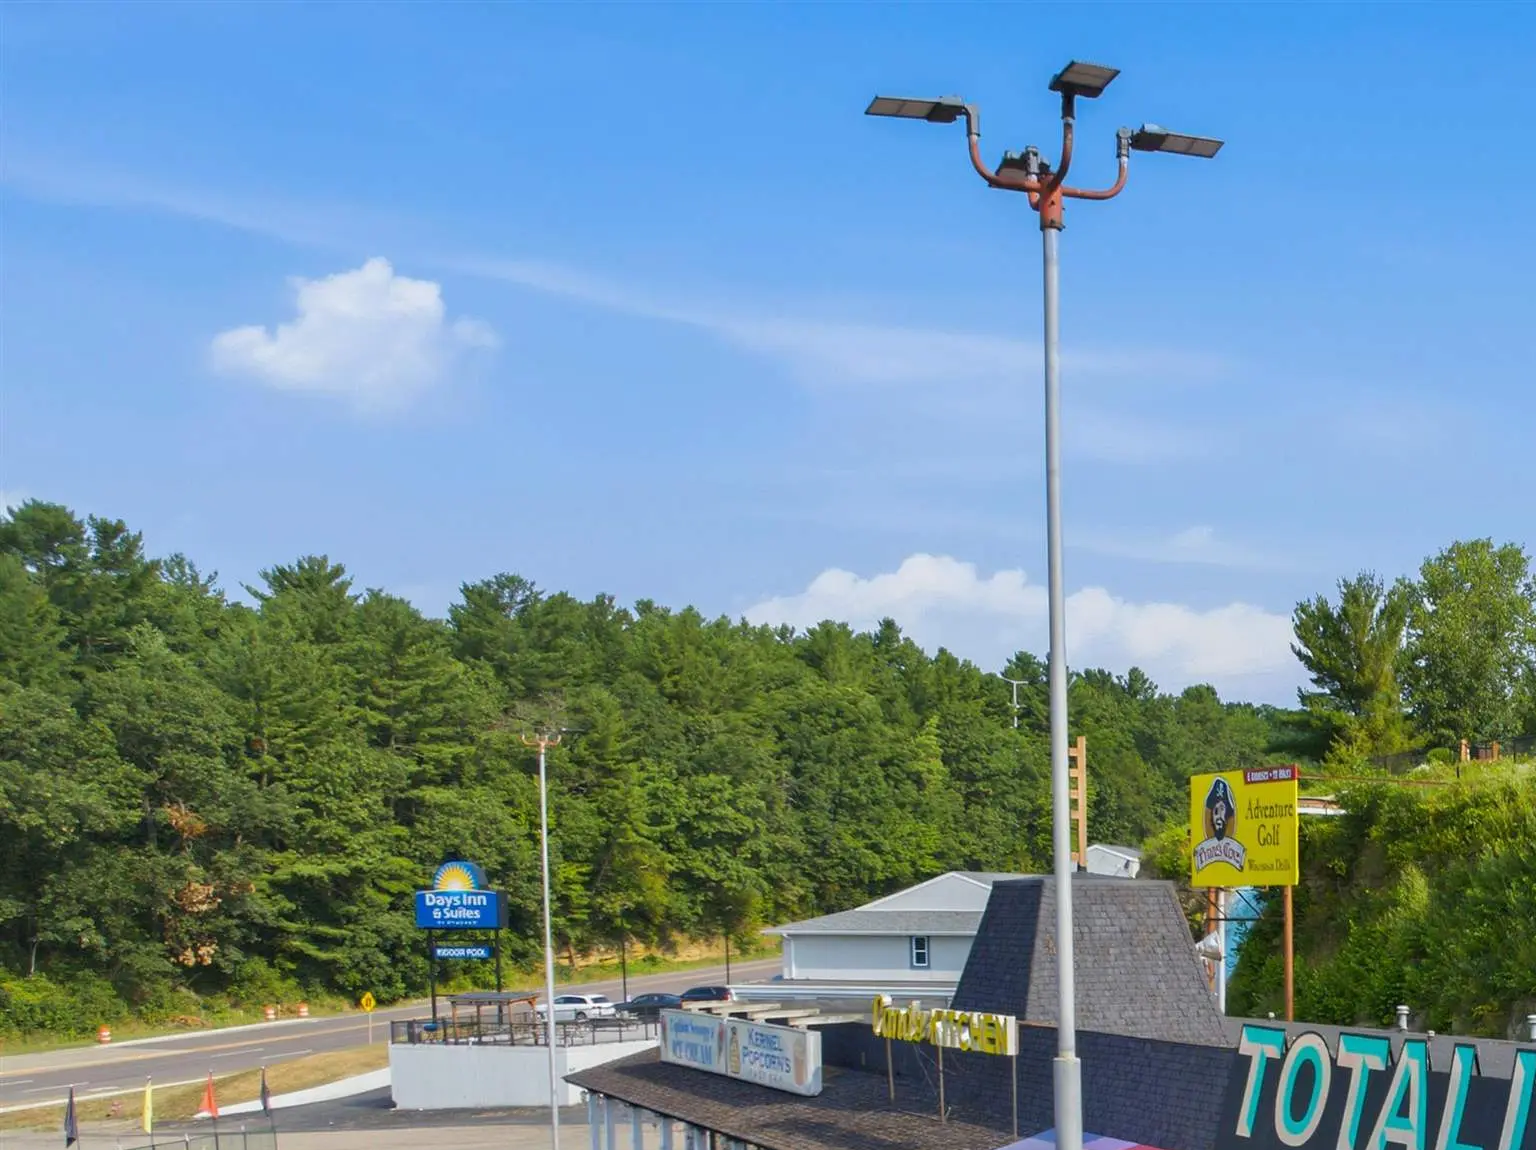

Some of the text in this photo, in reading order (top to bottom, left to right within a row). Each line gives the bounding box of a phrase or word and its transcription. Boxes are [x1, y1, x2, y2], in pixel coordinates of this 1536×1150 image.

[1245, 797, 1293, 819] Adventure
[1257, 824, 1280, 846] Golf
[425, 894, 487, 907] Days Inn
[443, 906, 481, 919] Suites
[466, 948, 486, 957] POOL
[872, 994, 1016, 1055] Candy KITCHEN
[748, 1028, 784, 1052] KERNEL
